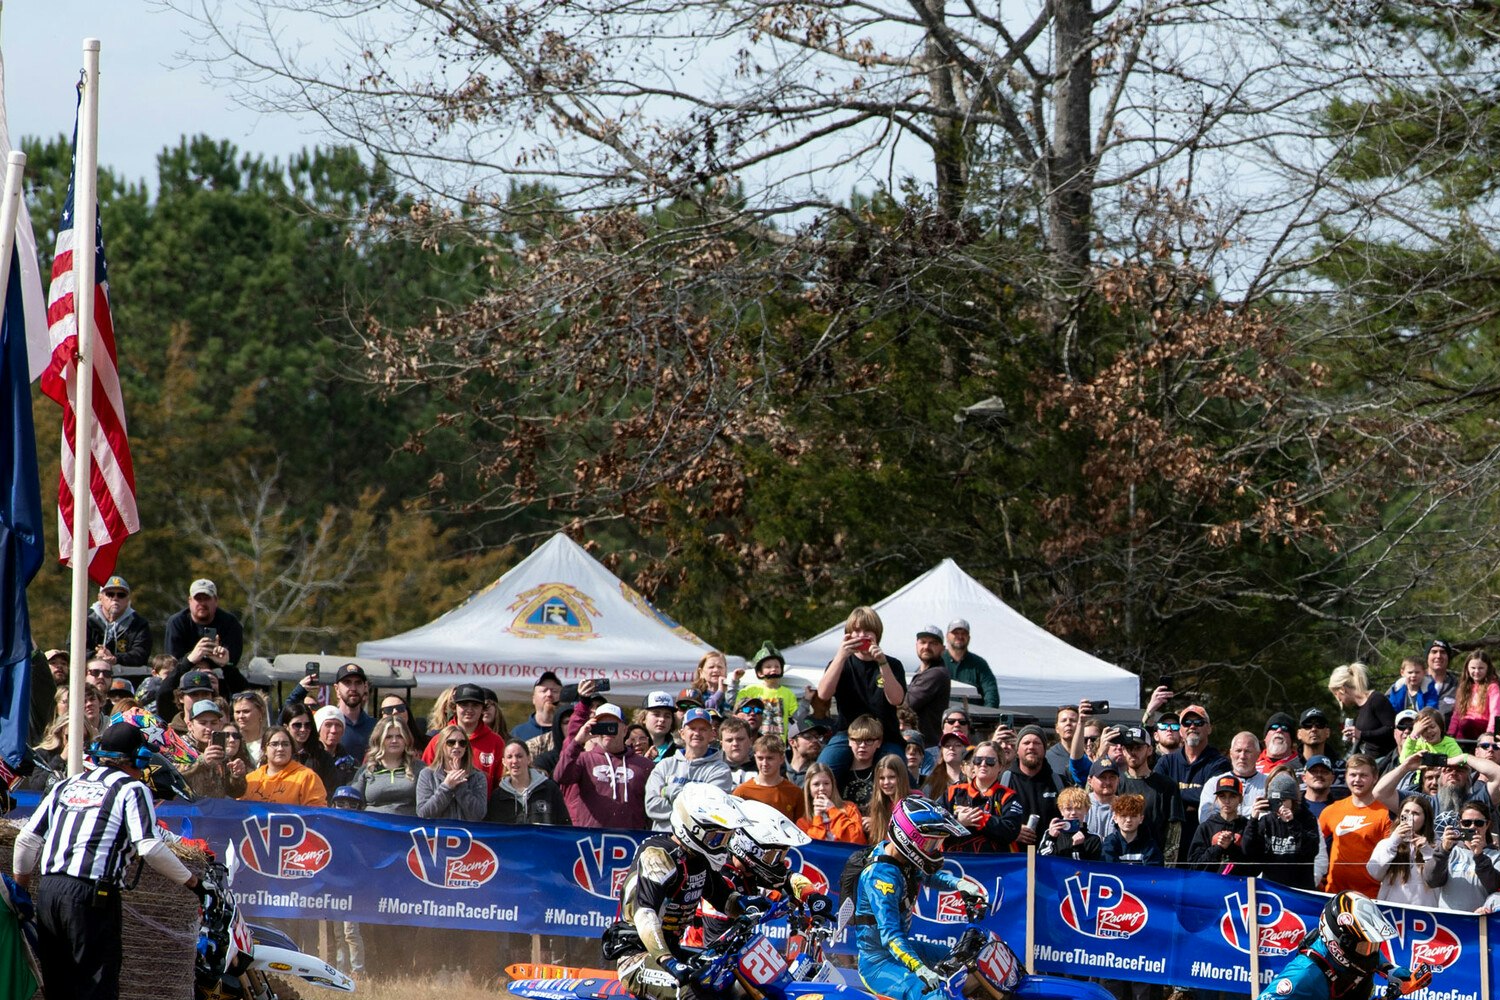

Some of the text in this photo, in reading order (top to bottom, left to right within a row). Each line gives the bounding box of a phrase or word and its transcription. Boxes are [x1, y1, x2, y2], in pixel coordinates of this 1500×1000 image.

[610, 668, 698, 683] ASSOCIATI
[242, 813, 307, 875] VP
[283, 847, 329, 867] Racing
[410, 826, 474, 887] VP
[283, 869, 314, 878] FUELS
[448, 858, 496, 878] Racing
[448, 879, 481, 888] FUELS
[378, 897, 518, 922] #MoreThanRaceFuel
[1065, 872, 1125, 936] VP
[1100, 909, 1147, 928] Racing
[1099, 929, 1130, 939] FUELS
[1260, 927, 1306, 947] Racing
[742, 937, 786, 984] 212
[1033, 944, 1166, 974] #MoreThanRaceFuel
[1258, 946, 1290, 956] FUELS
[1414, 943, 1461, 964] Racing
